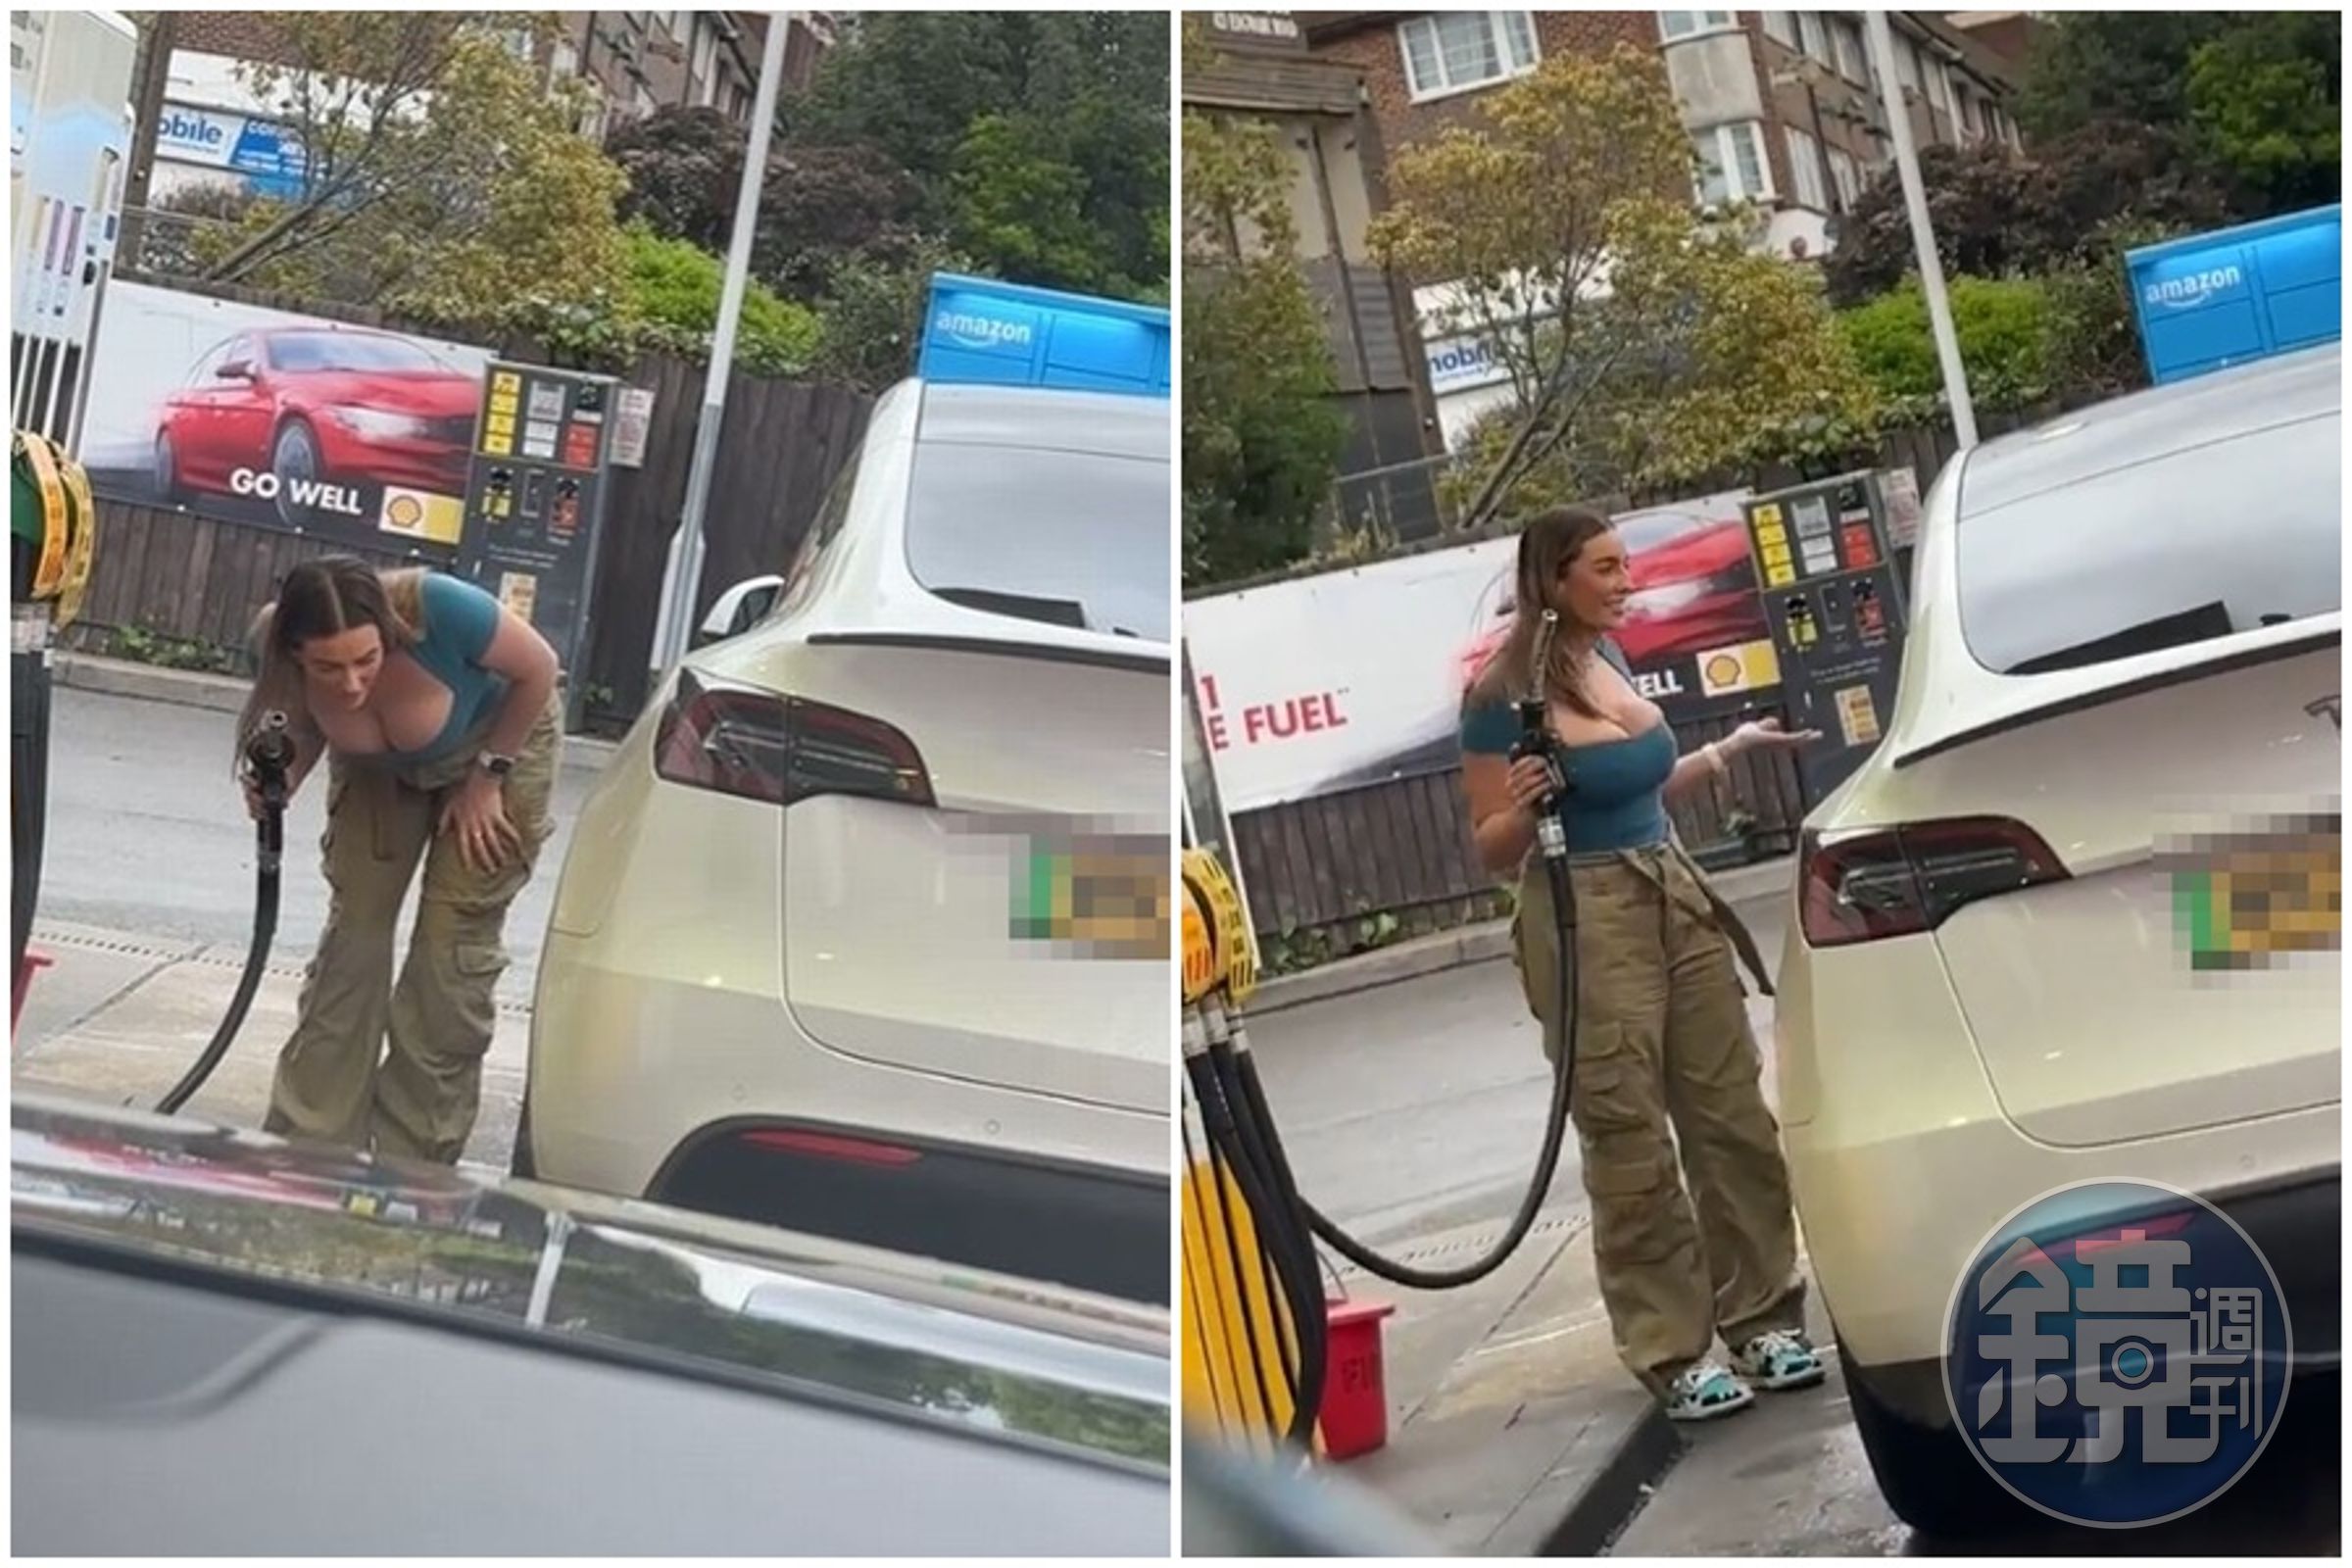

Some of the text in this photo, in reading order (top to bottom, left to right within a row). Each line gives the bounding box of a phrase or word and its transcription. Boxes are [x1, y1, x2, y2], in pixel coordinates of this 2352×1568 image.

[2145, 266, 2240, 303] amazon
[937, 311, 1031, 345] amazon
[229, 466, 363, 515] GO WELL
[1200, 674, 1219, 710] 1
[1631, 668, 1684, 699] ELL
[1243, 691, 1348, 744] FUEL
